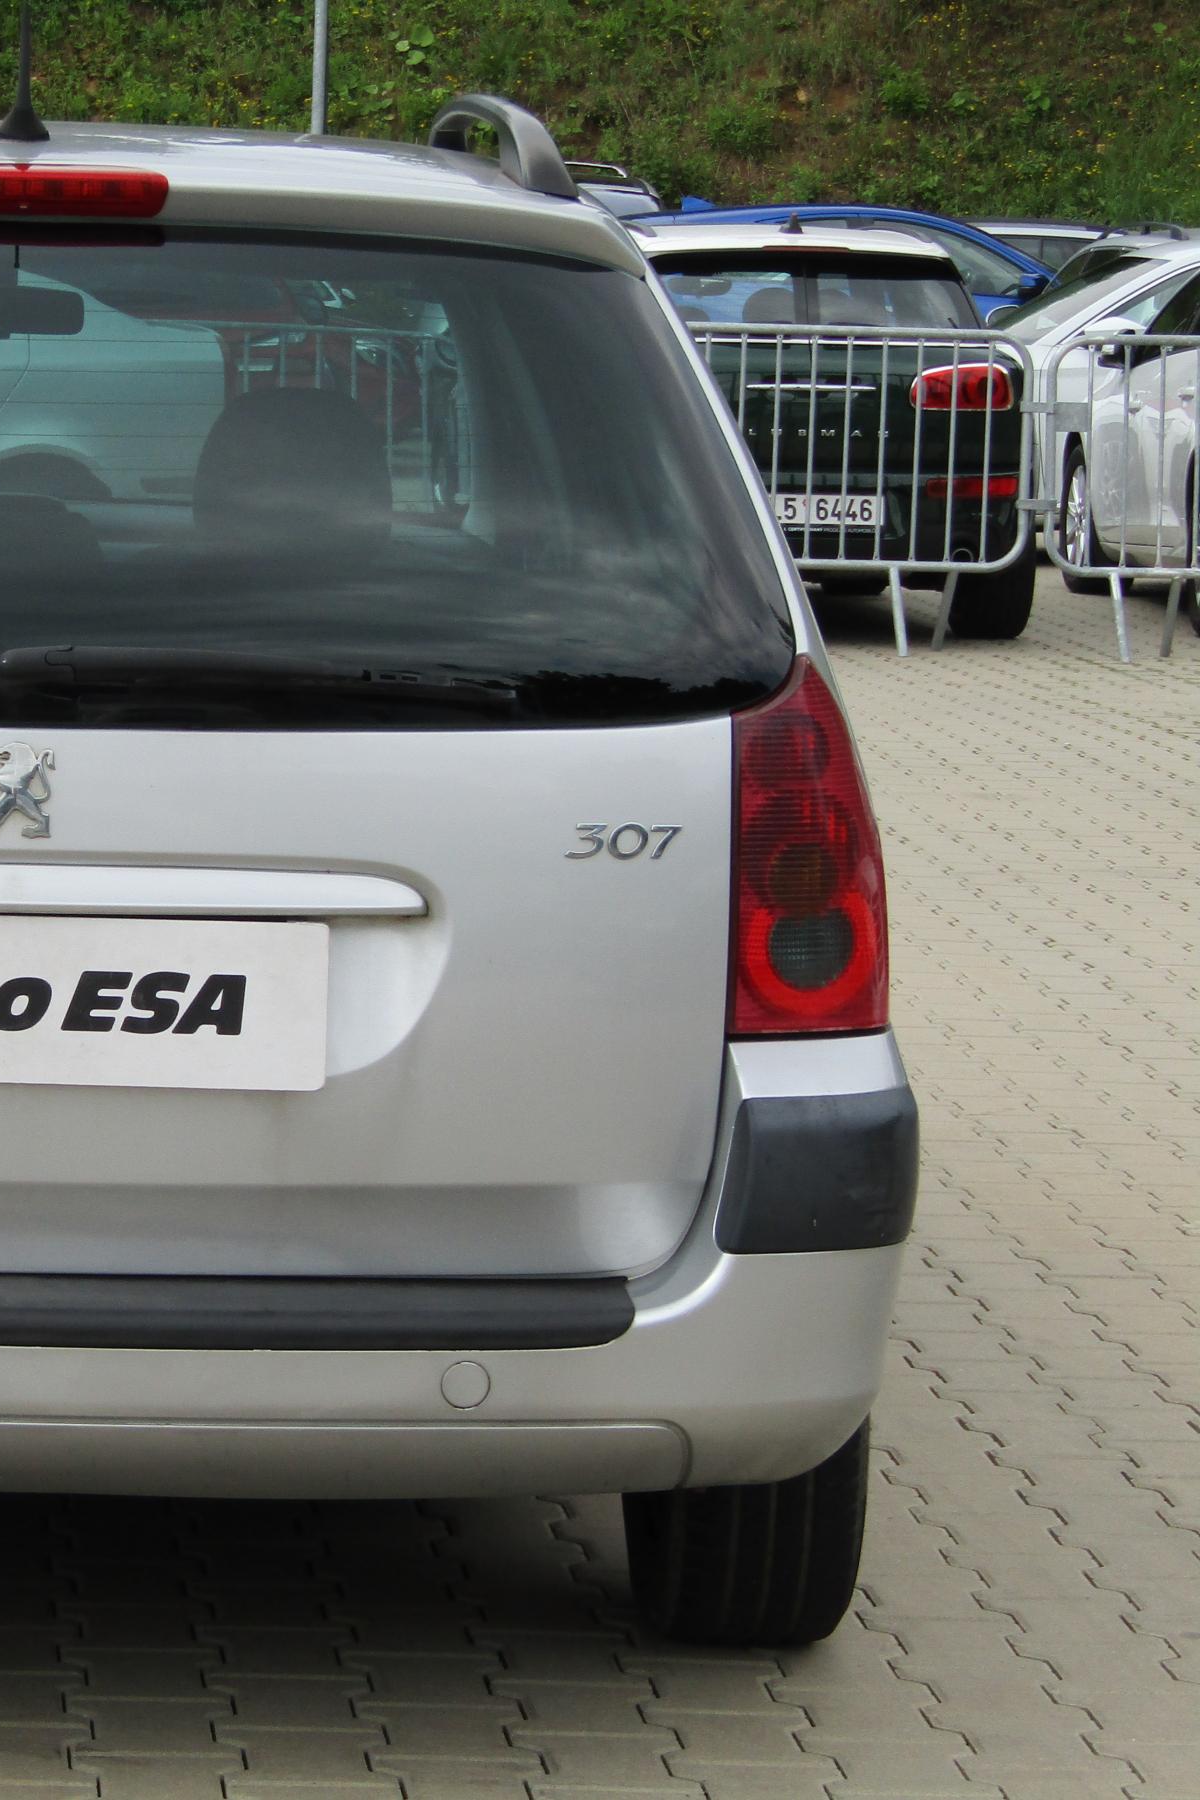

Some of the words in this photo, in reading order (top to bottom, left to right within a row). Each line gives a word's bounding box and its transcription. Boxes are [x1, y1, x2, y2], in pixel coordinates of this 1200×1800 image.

[777, 497, 797, 520] 5
[815, 498, 873, 522] 6446
[564, 822, 683, 861] 307
[61, 970, 247, 1035] ESA
